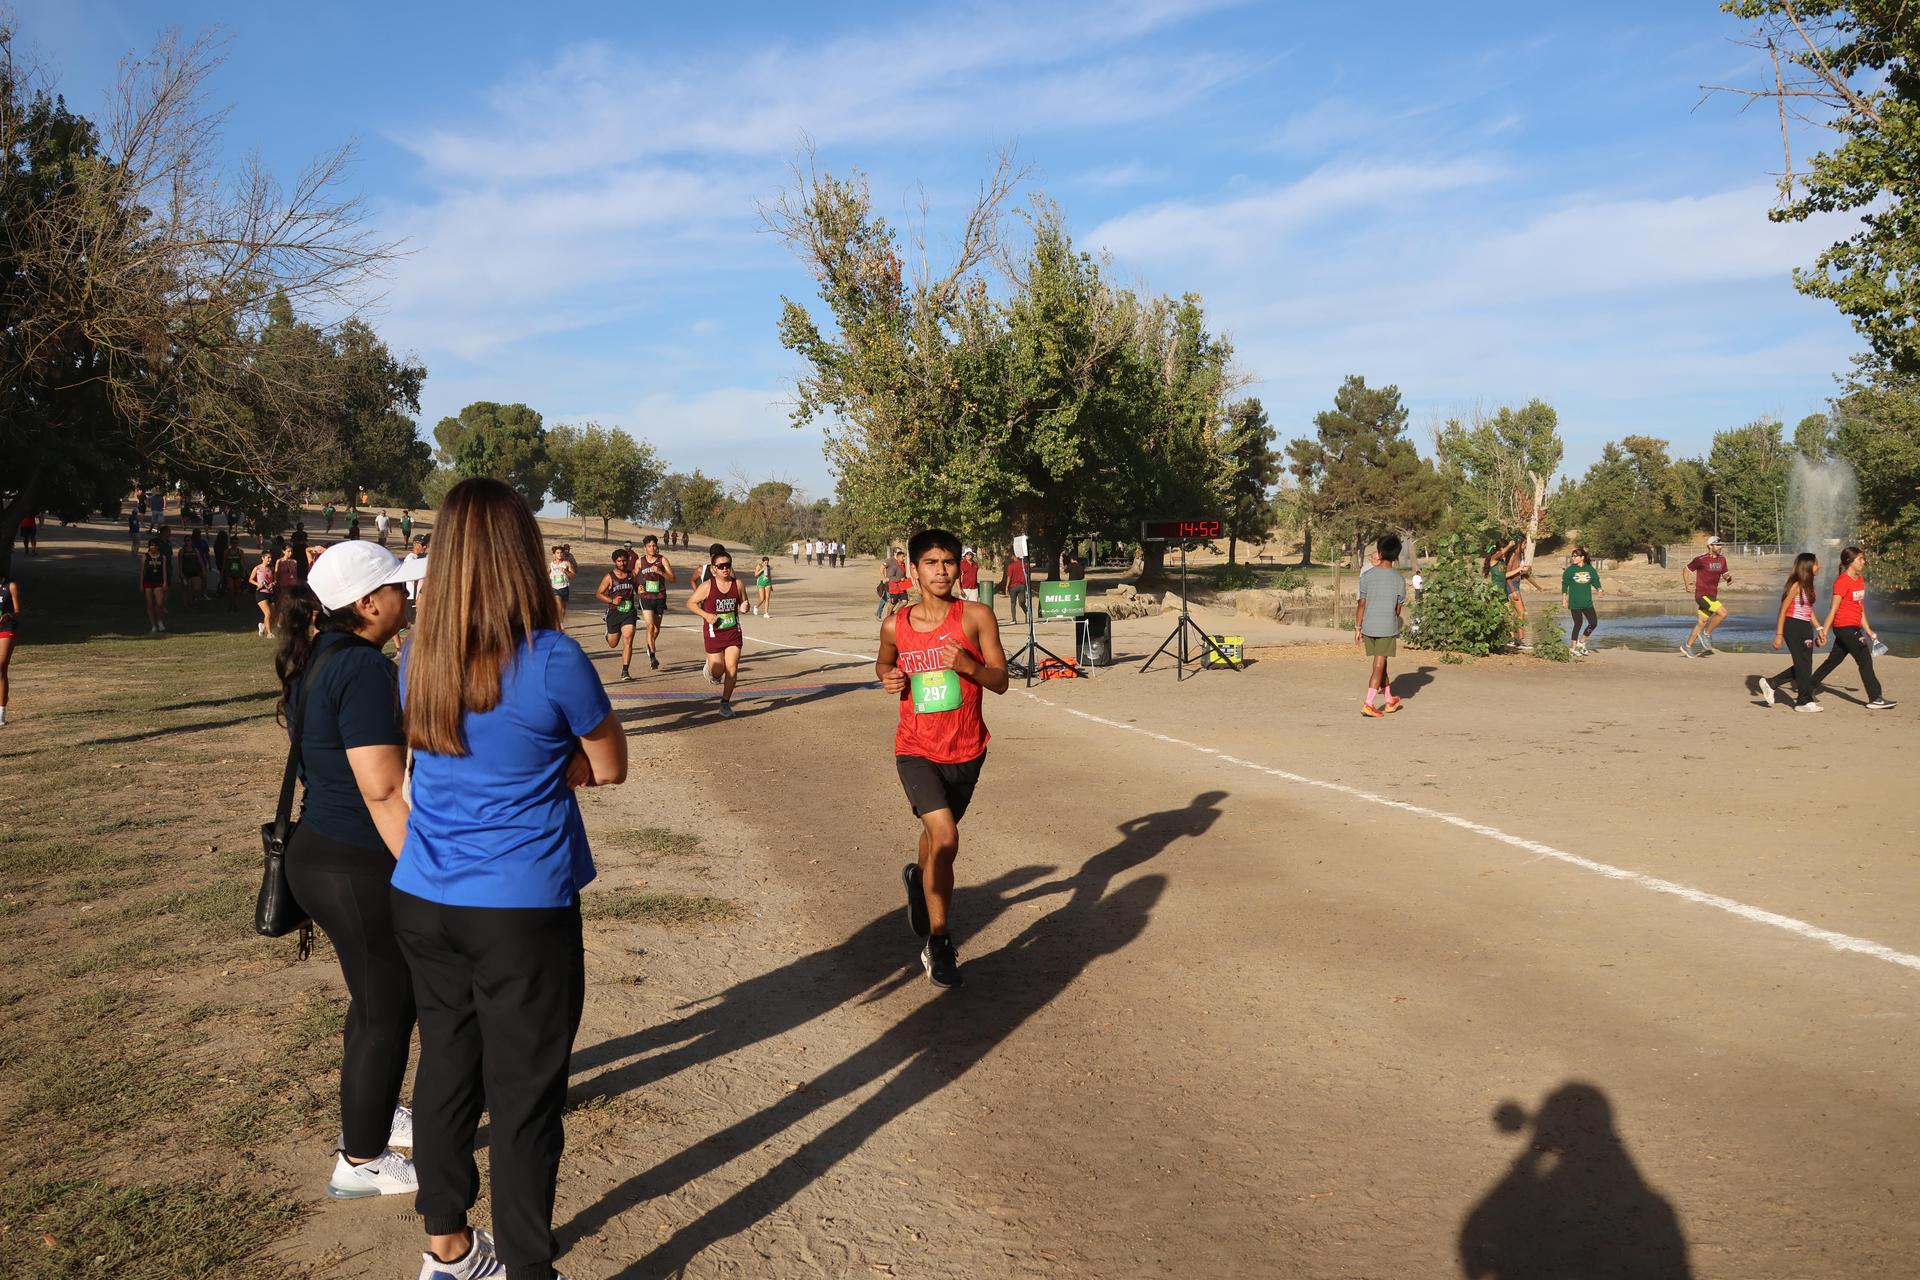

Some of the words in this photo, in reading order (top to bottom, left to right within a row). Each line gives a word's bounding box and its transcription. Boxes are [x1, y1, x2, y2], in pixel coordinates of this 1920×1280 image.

[1180, 521, 1219, 537] 14:52
[1045, 594, 1072, 603] MILE
[1074, 593, 1080, 601] 1
[923, 685, 947, 701] 297
